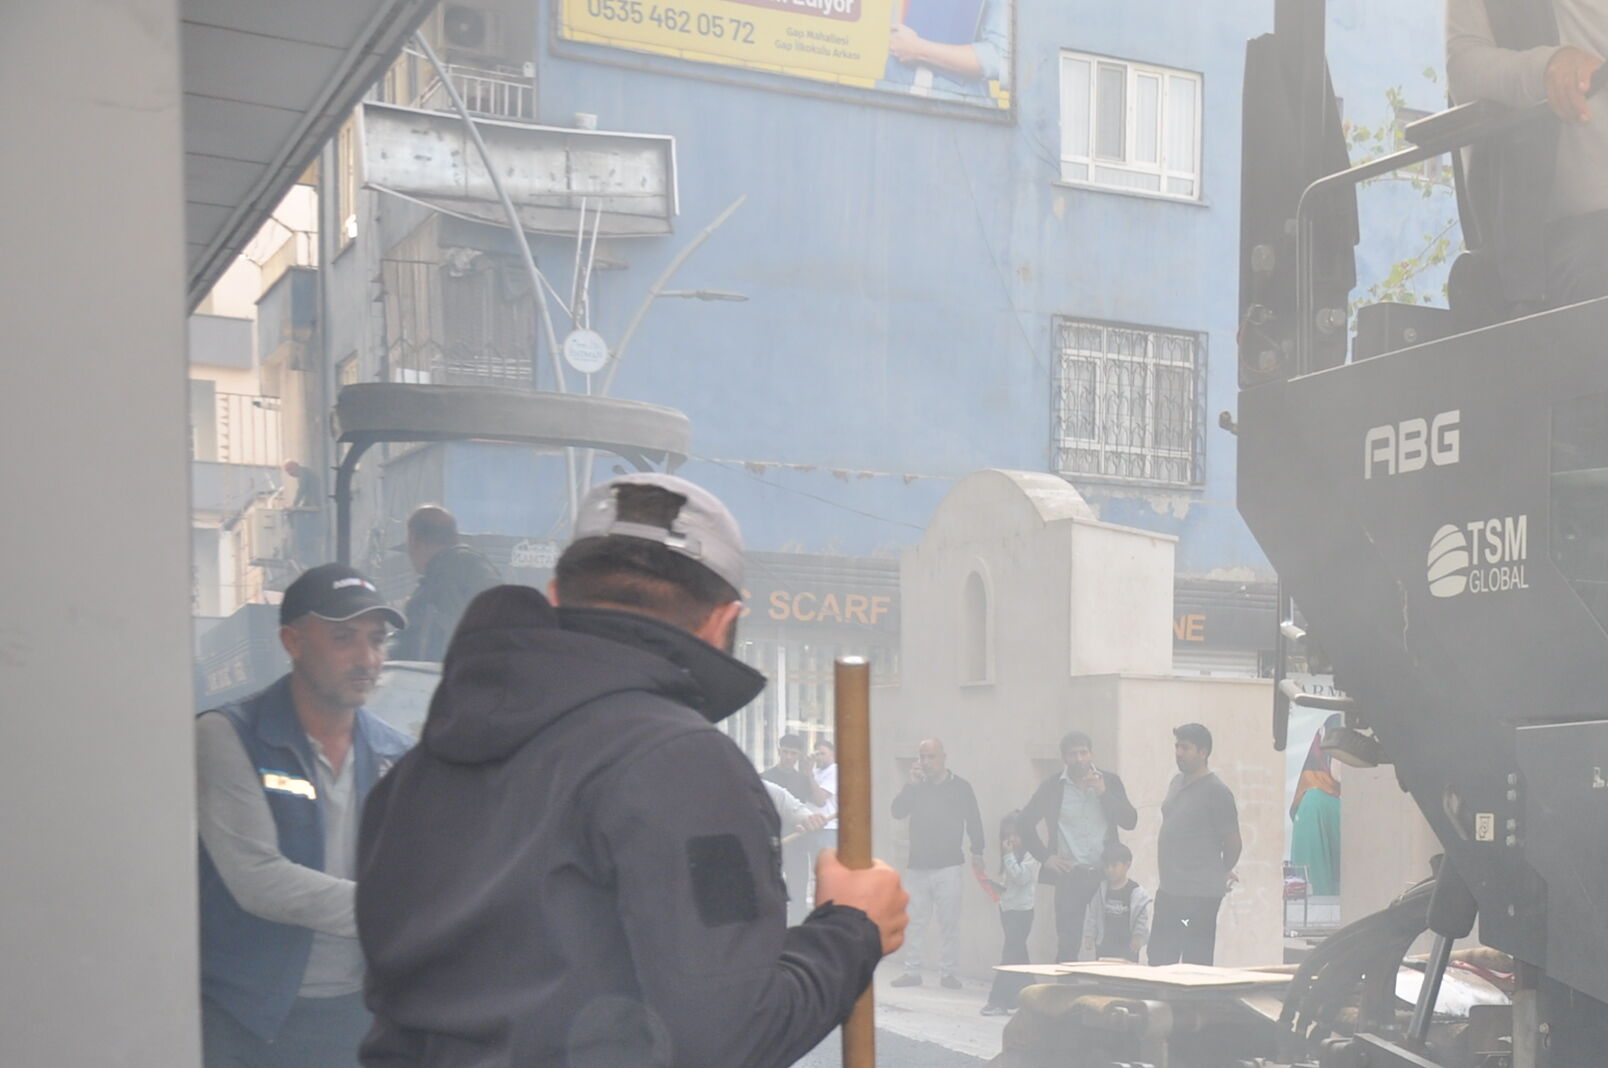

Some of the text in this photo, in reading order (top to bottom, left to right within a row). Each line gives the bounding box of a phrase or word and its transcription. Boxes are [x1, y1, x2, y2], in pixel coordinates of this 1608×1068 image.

[587, 0, 755, 44] 0535 462 05 72
[785, 27, 805, 39] Gap
[774, 39, 793, 52] Gap
[1364, 408, 1461, 480] ABG
[1467, 514, 1528, 565] TSM
[1469, 564, 1530, 594] GLOBAL
[767, 588, 891, 625] SCARF
